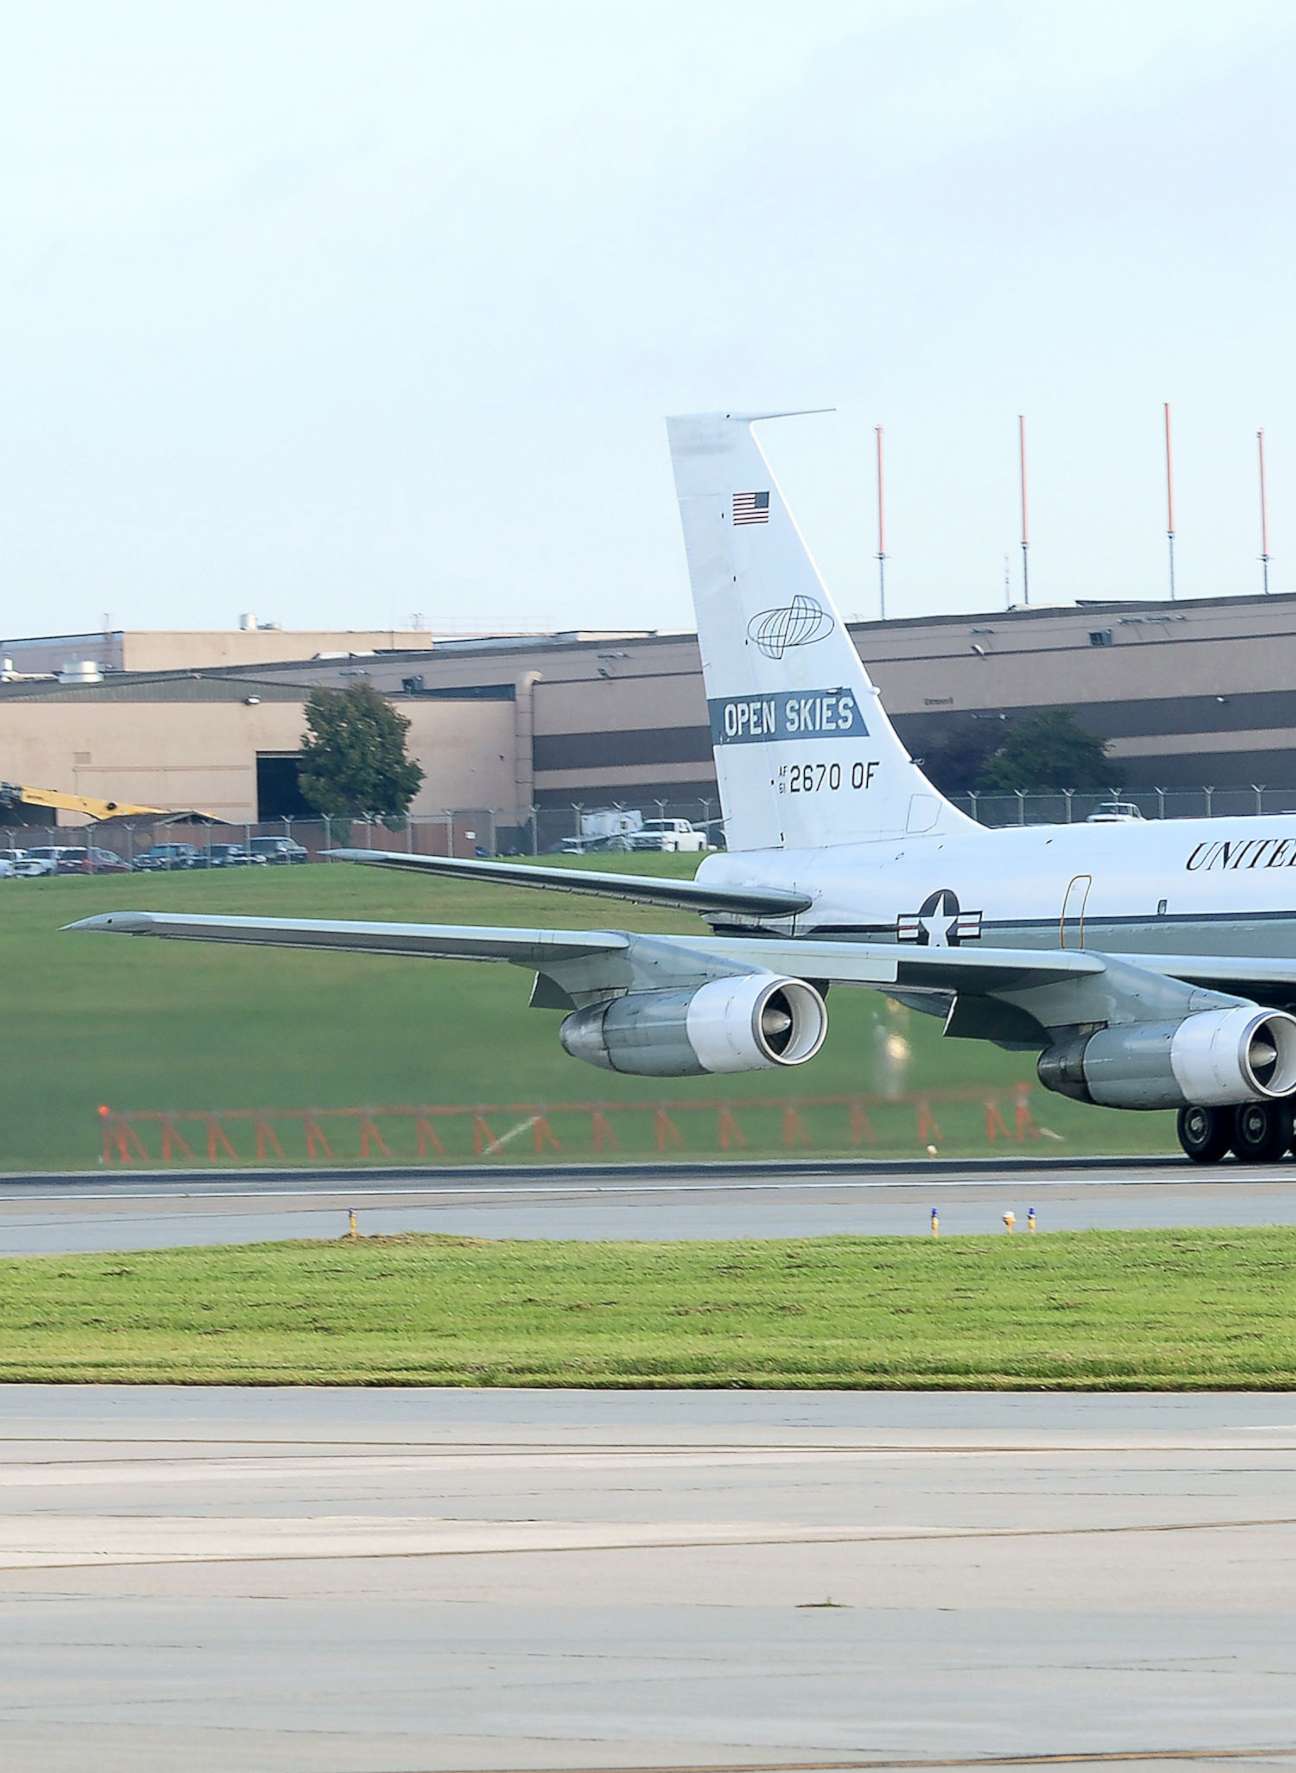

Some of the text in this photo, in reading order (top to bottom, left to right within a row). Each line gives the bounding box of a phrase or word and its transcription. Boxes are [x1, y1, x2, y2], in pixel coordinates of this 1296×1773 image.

[724, 696, 854, 736] OPEN SKIES
[790, 761, 880, 793] 2670 OF
